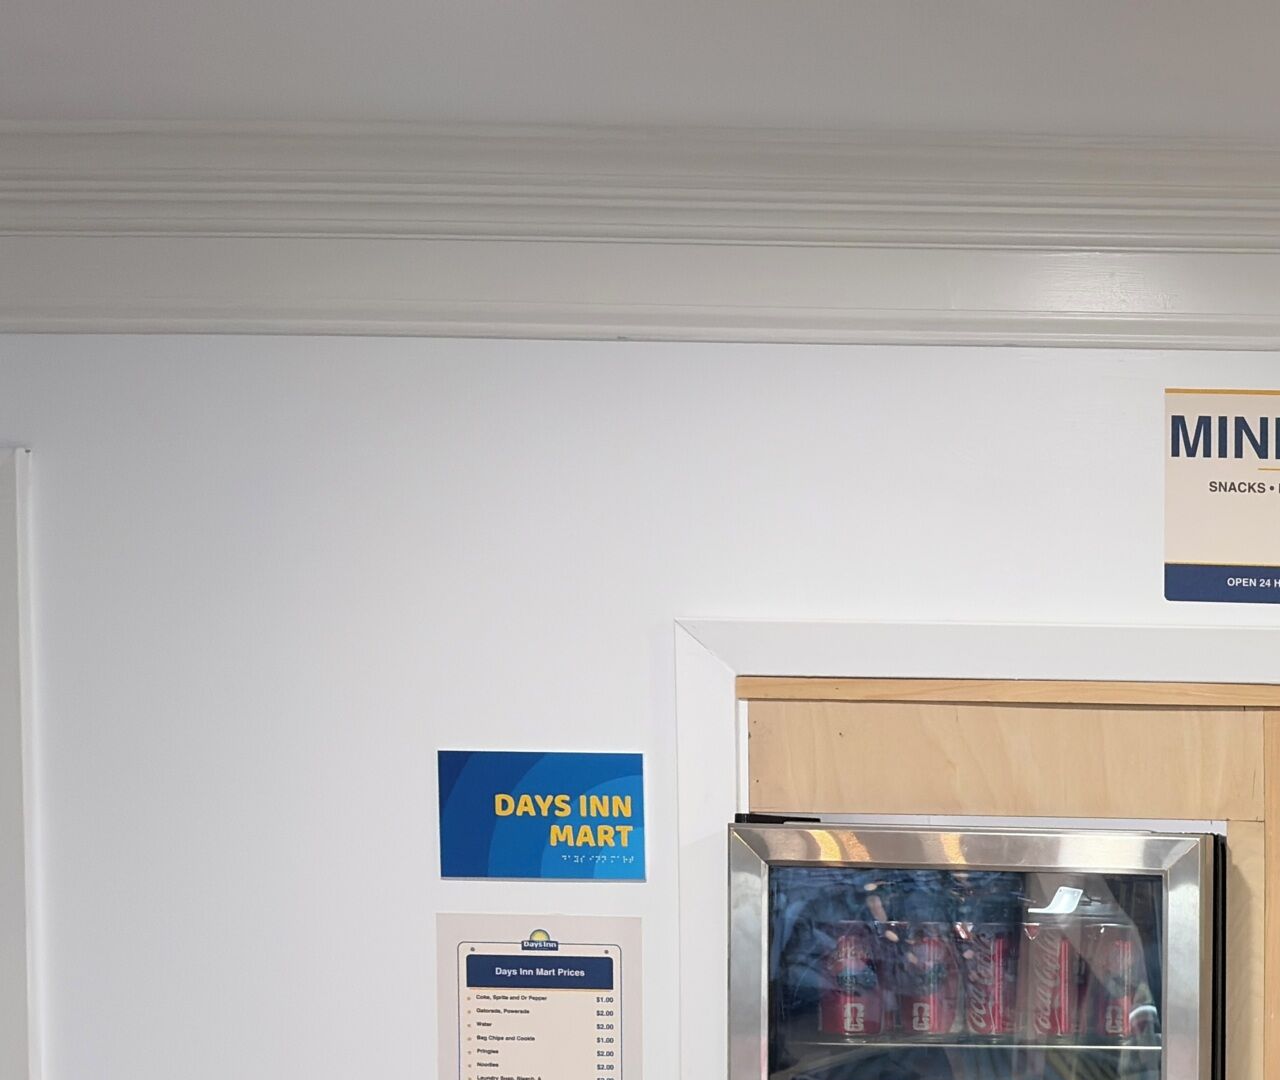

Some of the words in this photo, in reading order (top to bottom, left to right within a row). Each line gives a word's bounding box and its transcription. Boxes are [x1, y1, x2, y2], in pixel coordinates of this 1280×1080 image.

[1209, 481, 1266, 494] SNACKS
[1226, 577, 1257, 587] OPEN
[1260, 578, 1271, 588] 24
[494, 794, 571, 817] DAYS
[580, 795, 632, 818] INN
[550, 825, 634, 848] MART
[495, 967, 518, 977] Days
[520, 968, 533, 976] Inn
[536, 968, 555, 976] Mart
[558, 969, 585, 977] Prices
